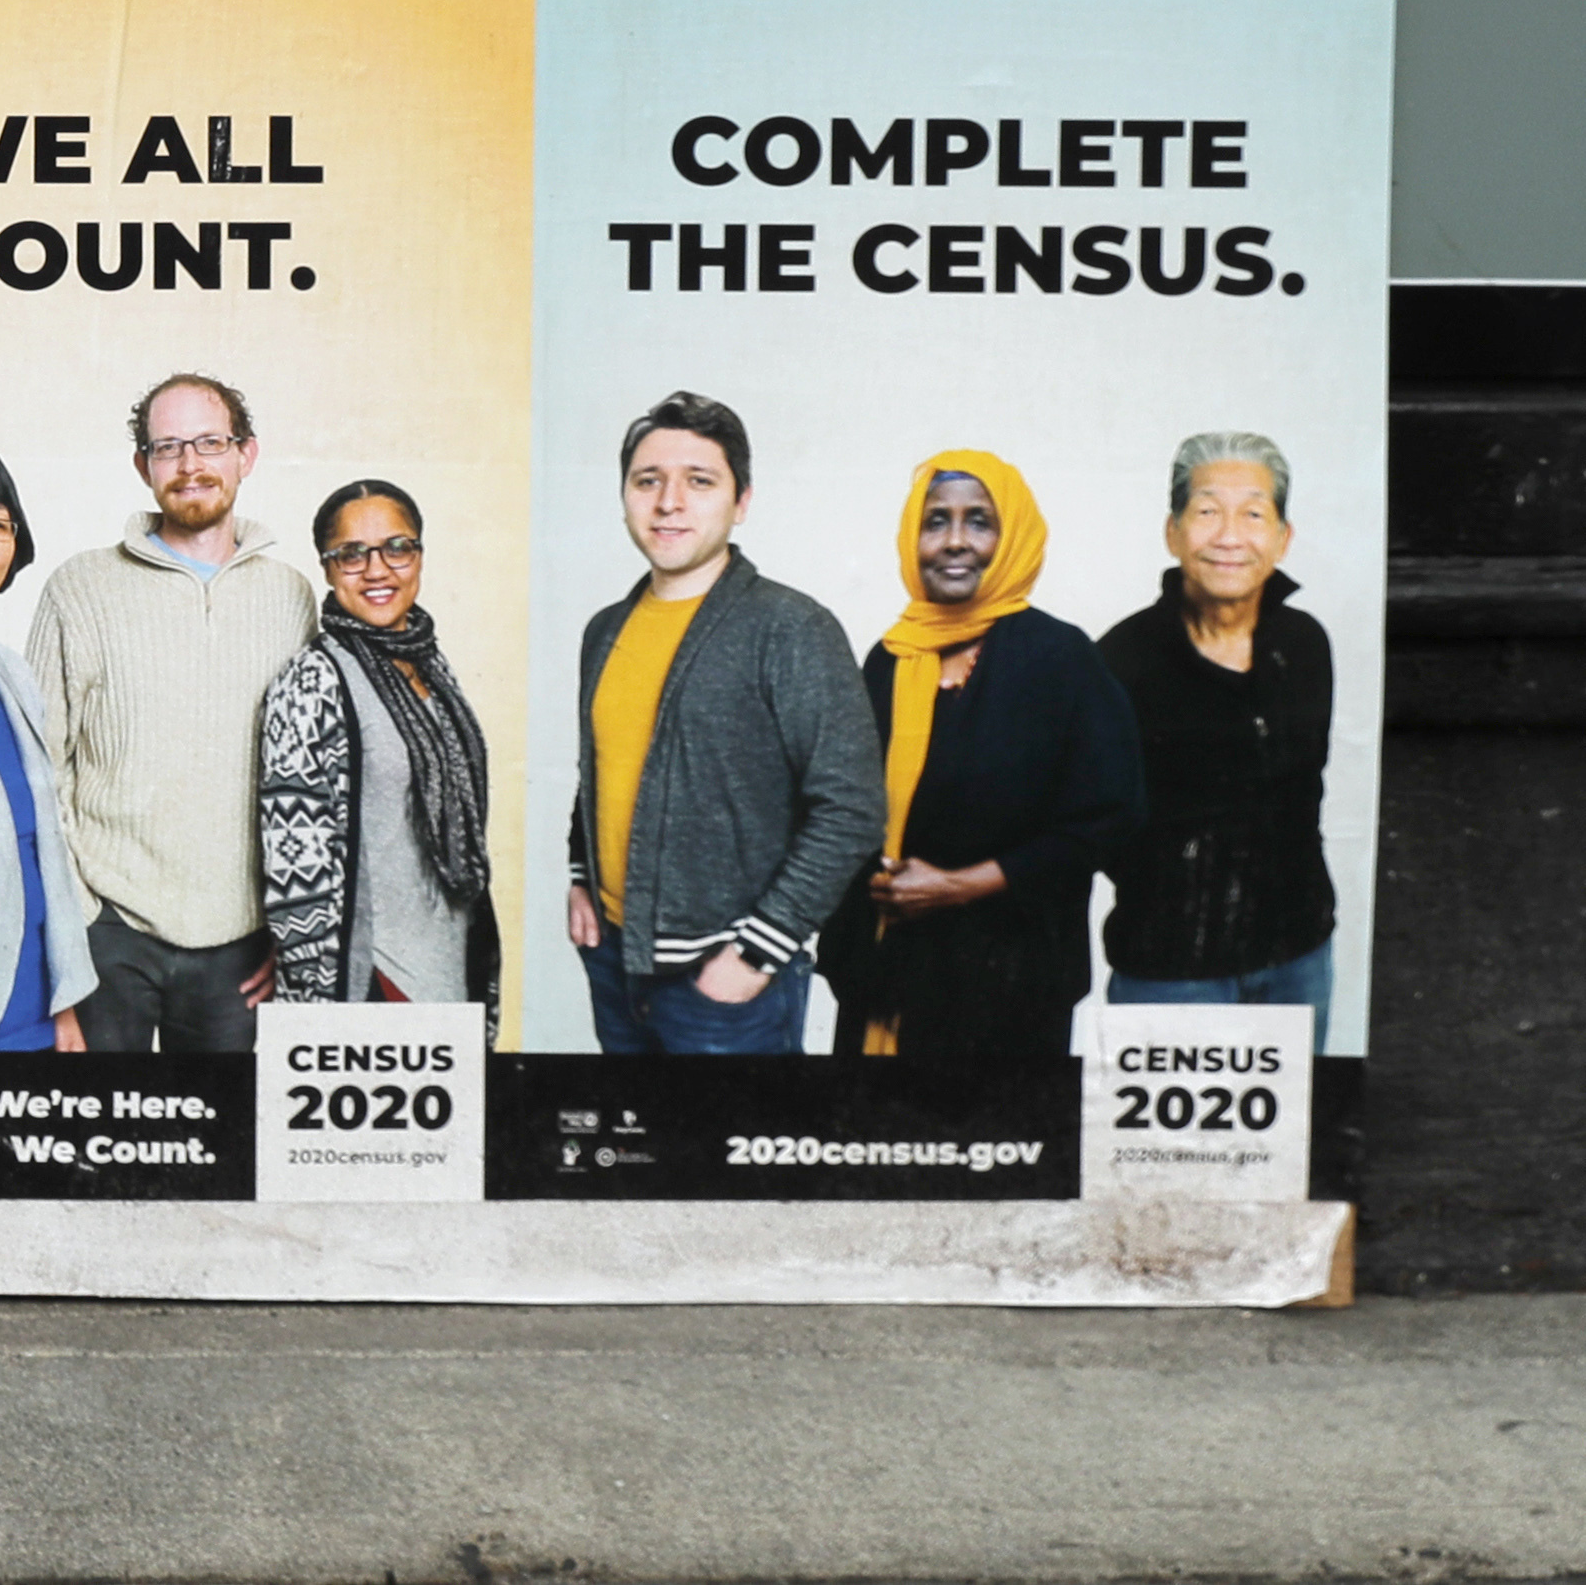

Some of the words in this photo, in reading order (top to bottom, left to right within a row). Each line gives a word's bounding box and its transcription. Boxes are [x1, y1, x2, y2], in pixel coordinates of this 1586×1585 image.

[121, 115, 324, 184] ALL
[671, 115, 1248, 189] COMPLETE
[608, 223, 816, 292] THE
[852, 223, 1306, 297] CENSUS.
[287, 1044, 454, 1073] CENSUS
[1118, 1046, 1281, 1074] CENSUS
[112, 1091, 216, 1120] Here.
[286, 1084, 453, 1131] 2020
[1114, 1085, 1278, 1132] 2020
[11, 1136, 73, 1164] We
[84, 1136, 216, 1166] Count.
[288, 1148, 448, 1168] 2020census.gov
[726, 1136, 1043, 1172] 2020census.gov
